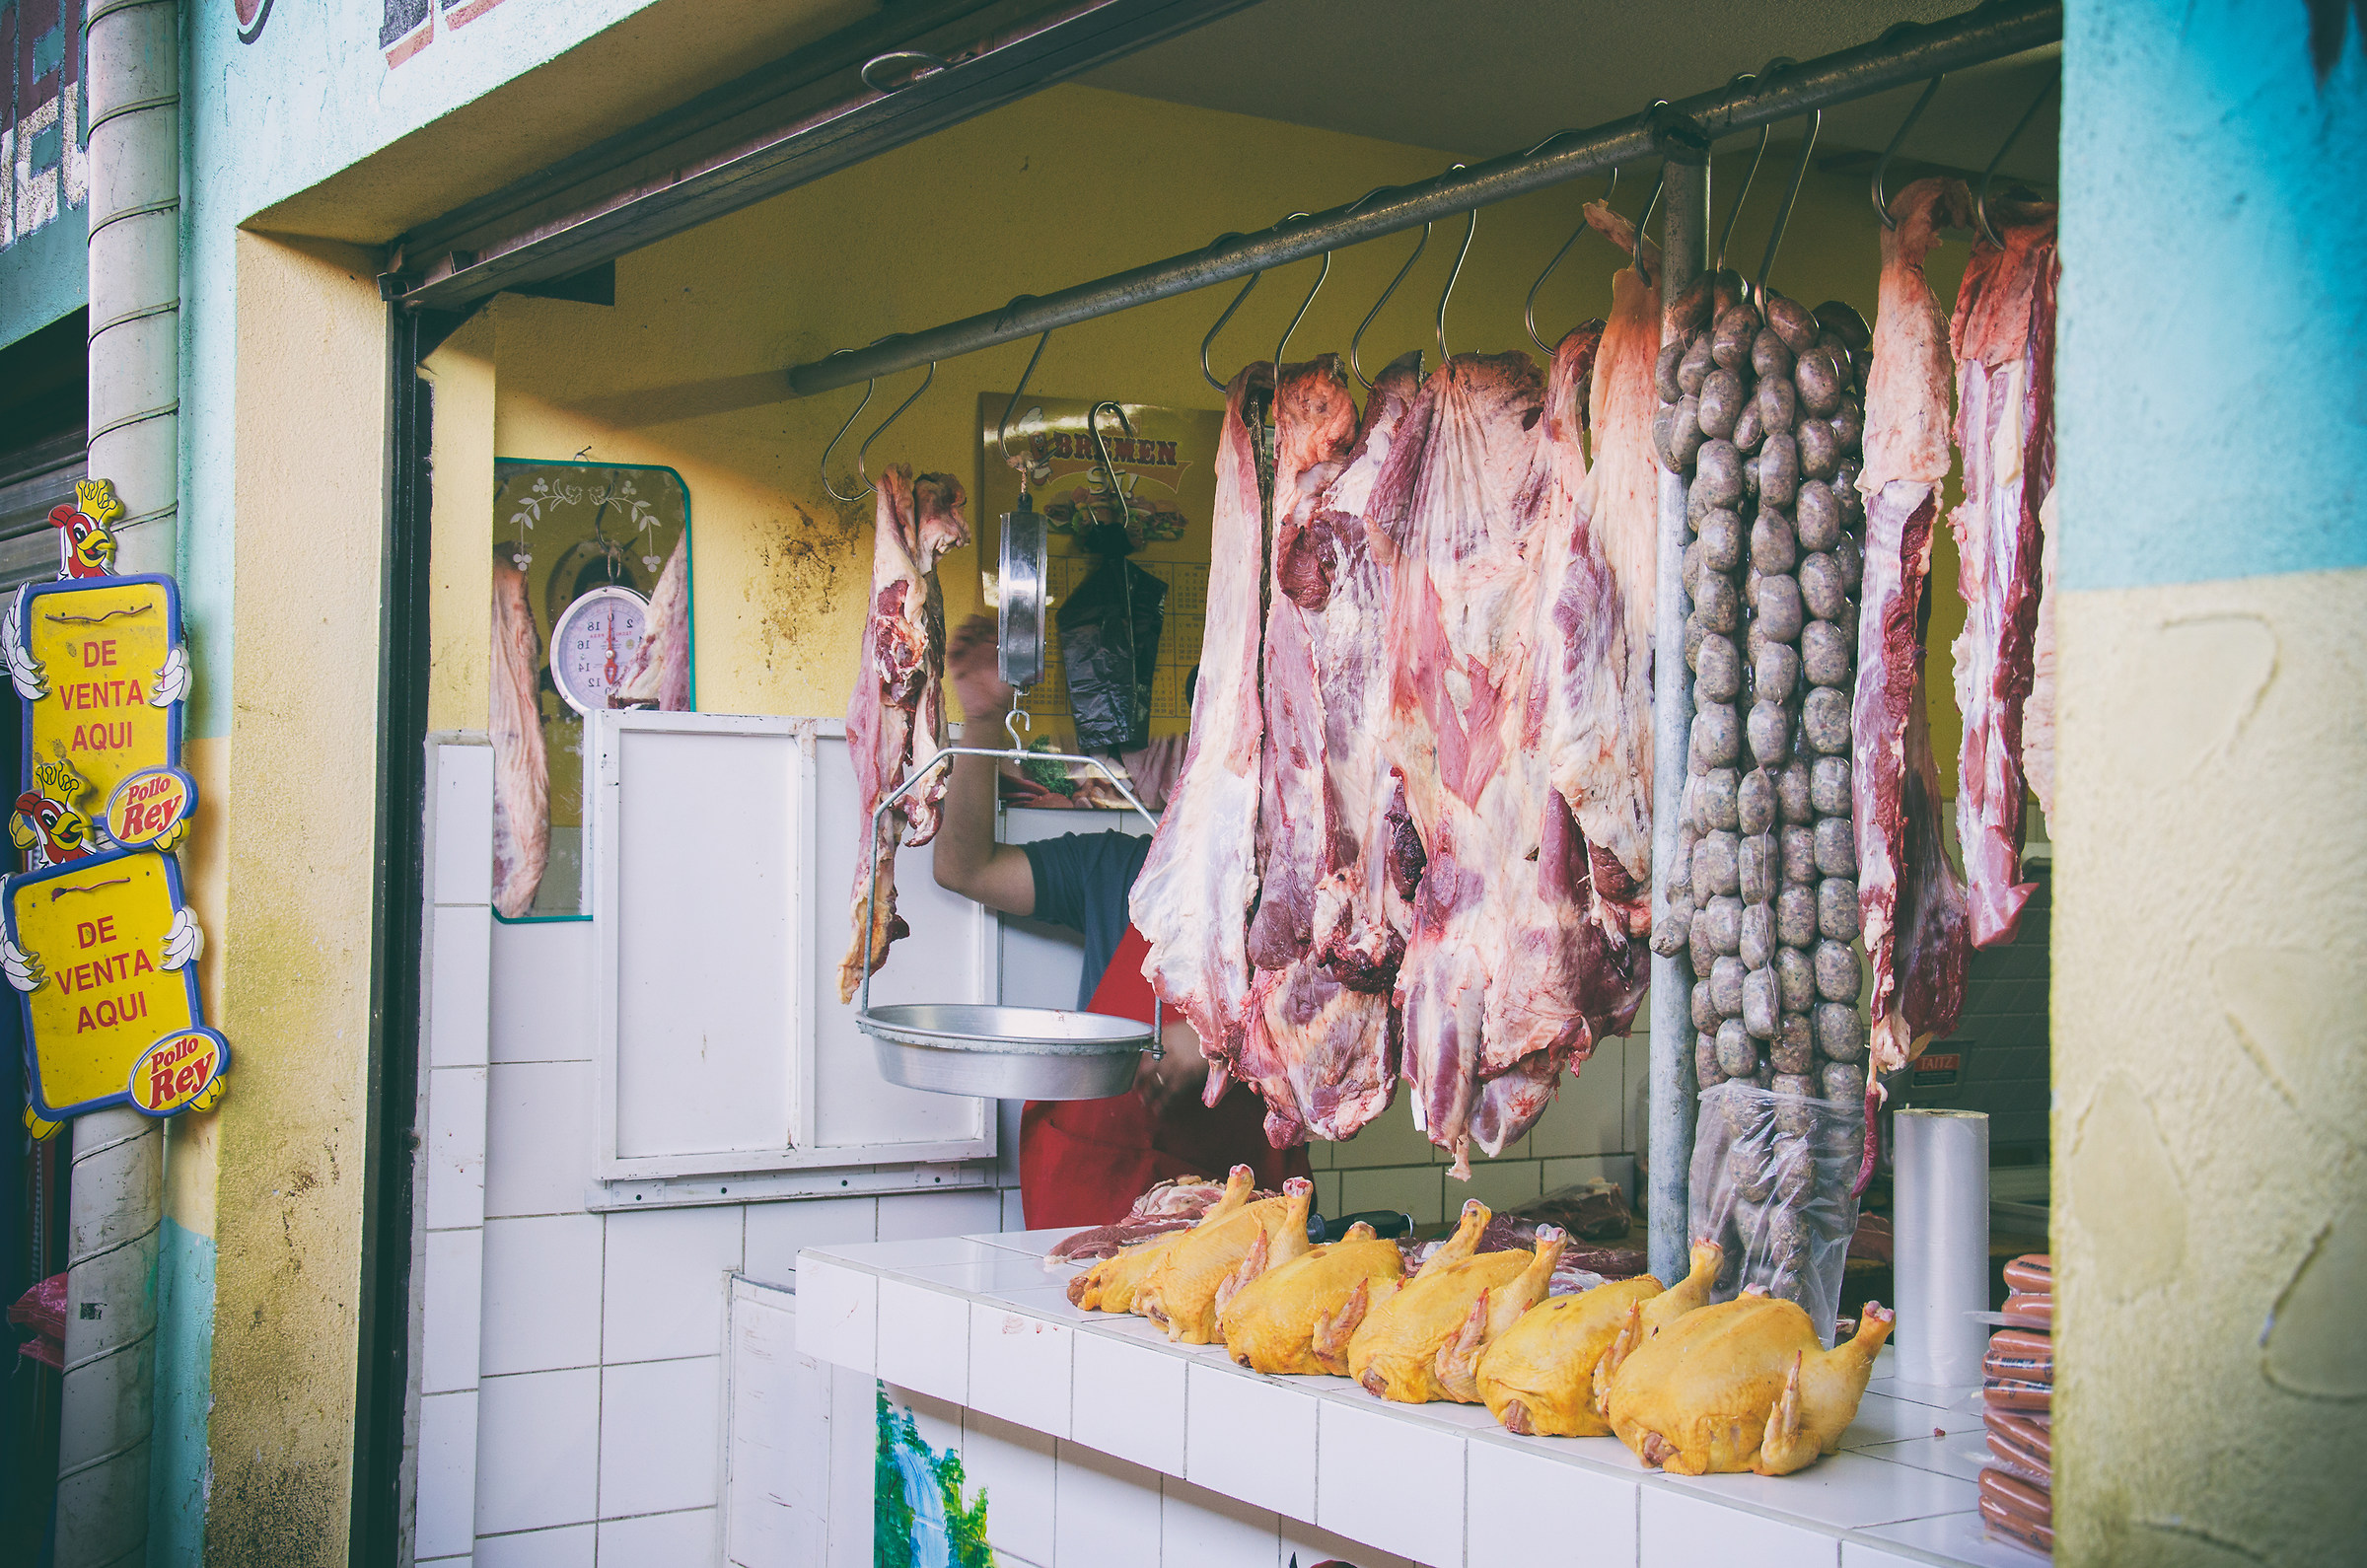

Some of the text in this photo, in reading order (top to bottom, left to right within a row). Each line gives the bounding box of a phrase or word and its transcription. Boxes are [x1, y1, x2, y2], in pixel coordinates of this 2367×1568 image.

[1053, 431, 1178, 465] BREMEN
[84, 640, 116, 668] DE
[59, 678, 144, 710] VENTA
[71, 721, 133, 751] AQUI
[127, 777, 171, 806] Pollo
[119, 793, 182, 840] Rey
[77, 916, 116, 949] DE
[55, 949, 154, 995] VENTA
[77, 991, 147, 1033] AQUI
[150, 1037, 198, 1074] Pollo
[149, 1051, 214, 1108] Rey
